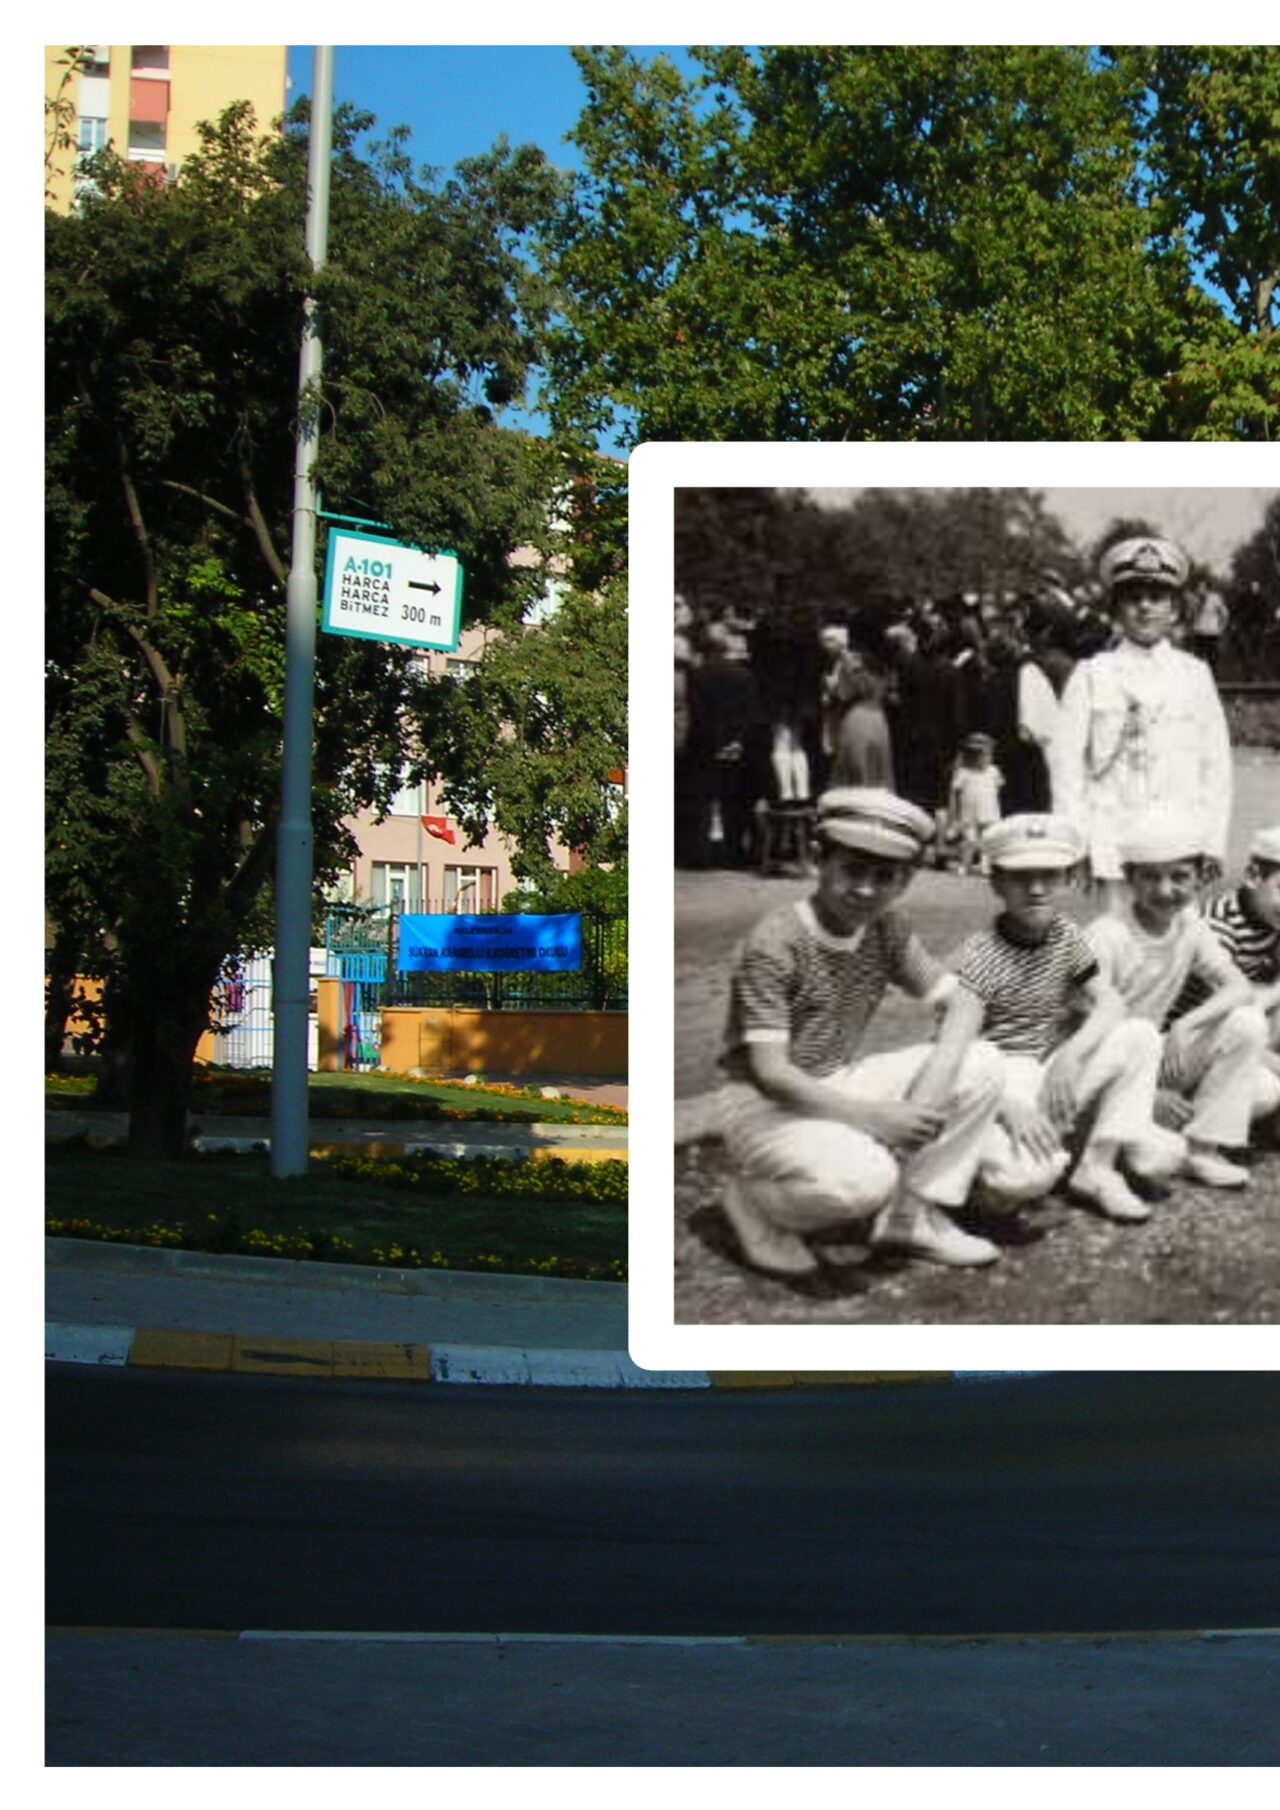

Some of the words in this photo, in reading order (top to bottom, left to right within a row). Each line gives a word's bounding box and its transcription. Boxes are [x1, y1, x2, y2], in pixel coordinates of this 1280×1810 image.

[342, 574, 390, 592] HARCA
[341, 587, 389, 604] HARCA
[401, 604, 426, 623] 300
[429, 615, 442, 626] m
